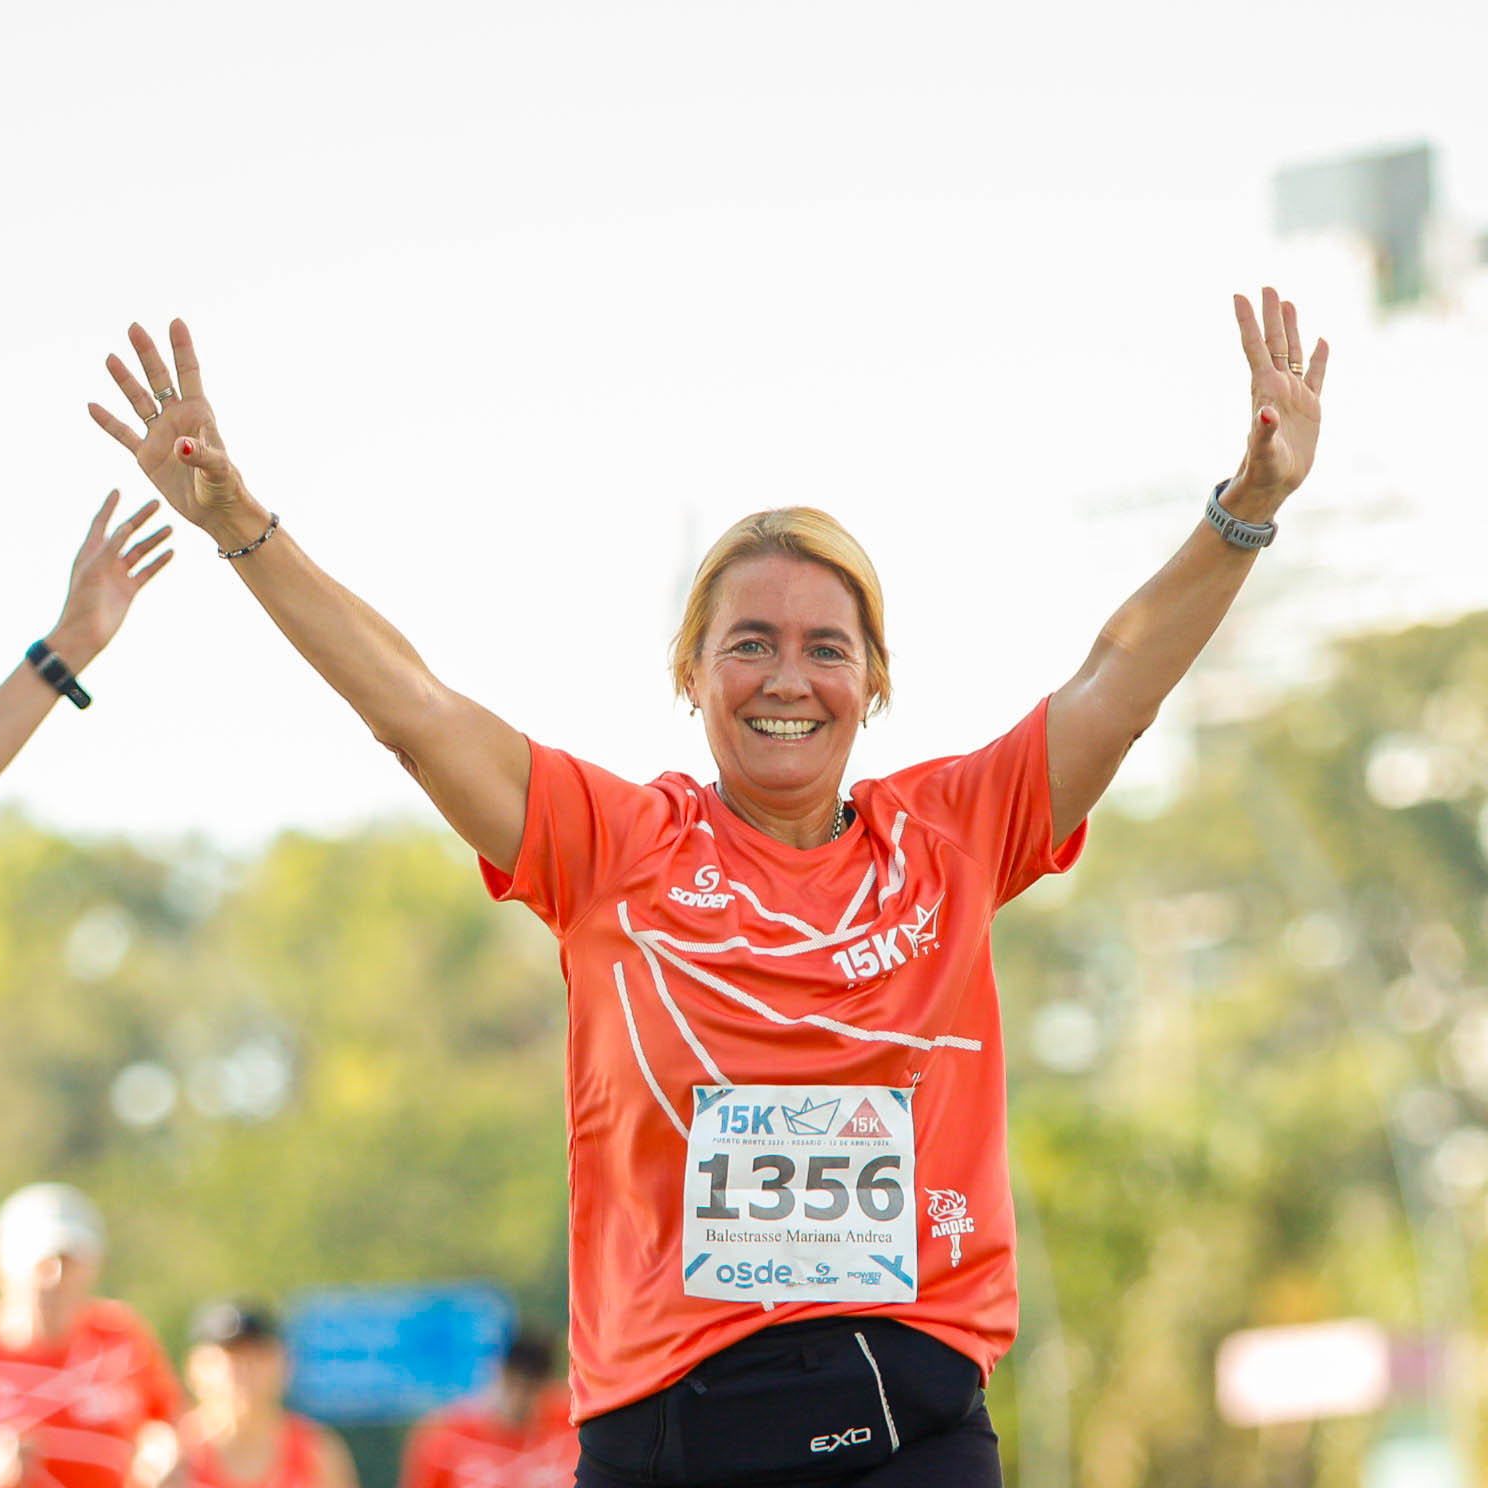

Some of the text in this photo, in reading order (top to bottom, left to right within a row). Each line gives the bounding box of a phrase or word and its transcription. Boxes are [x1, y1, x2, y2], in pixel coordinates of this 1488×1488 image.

[832, 927, 907, 979] 15K
[717, 1105, 776, 1135] 15K
[850, 1116, 881, 1134] 15K
[696, 1153, 905, 1222] 1356
[705, 1228, 893, 1244] Balestrasse Mariana Andrea
[931, 1217, 975, 1238] ARDEC
[716, 1258, 793, 1288] osde
[810, 1426, 872, 1452] EXO
